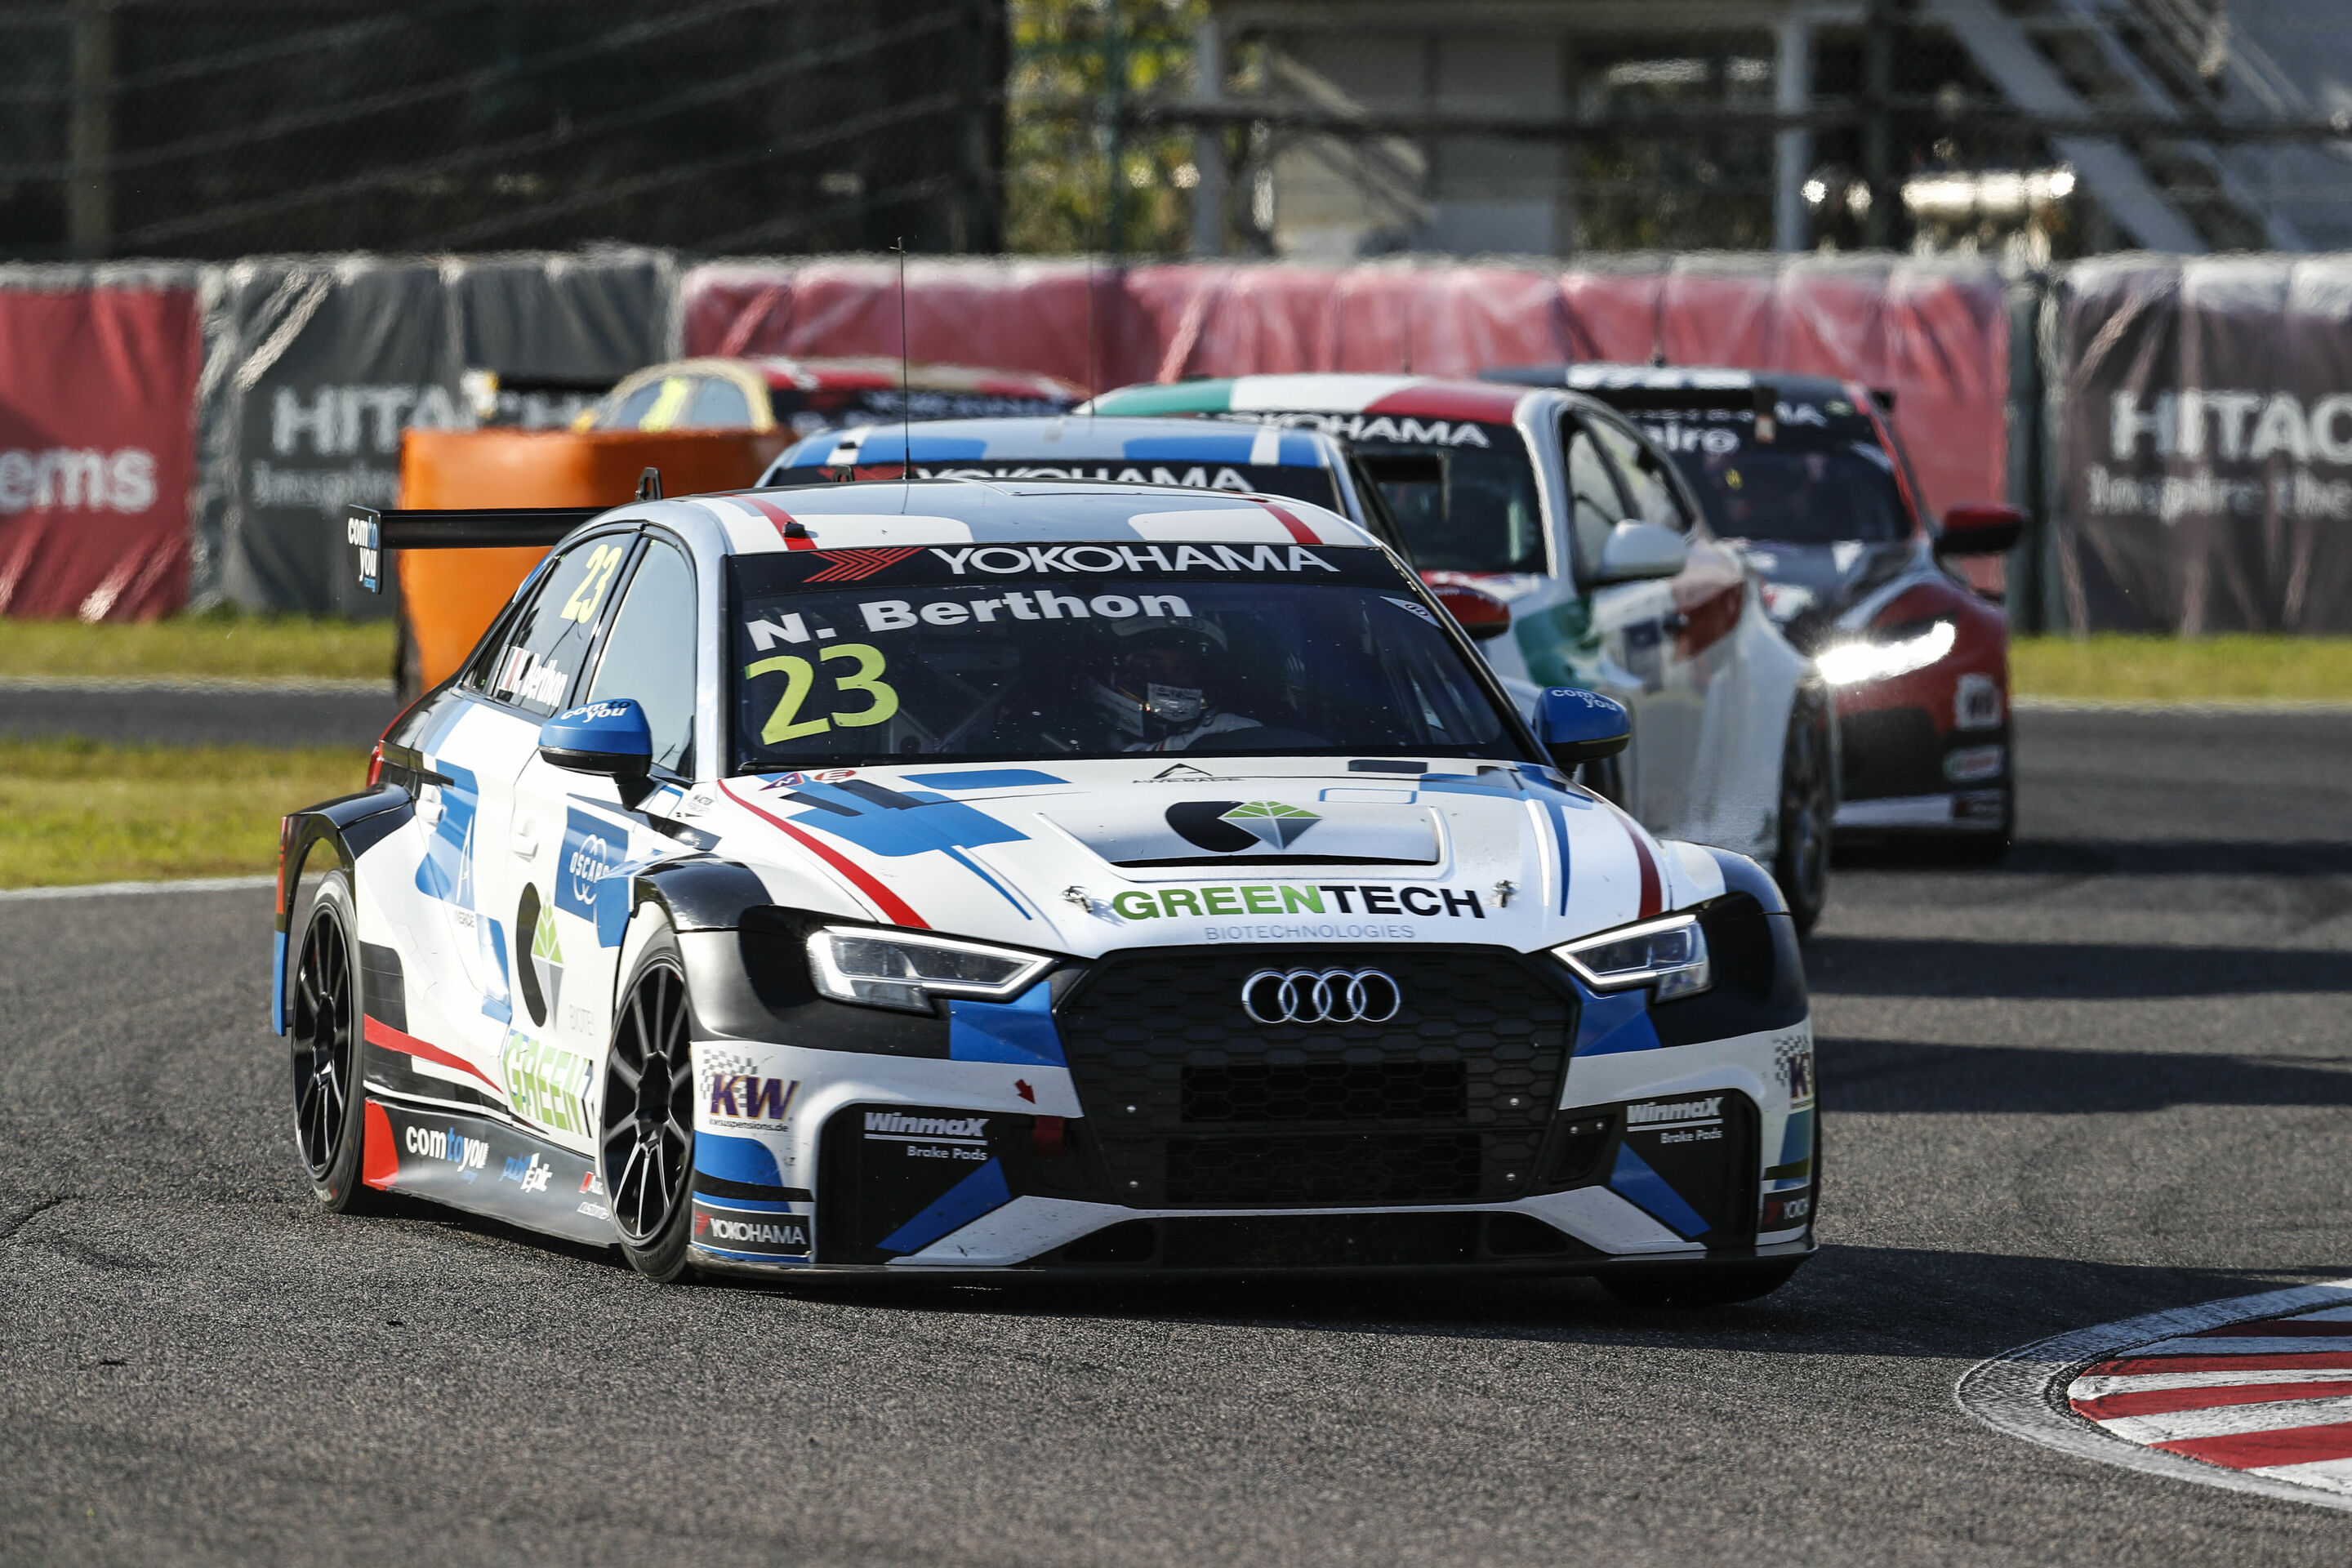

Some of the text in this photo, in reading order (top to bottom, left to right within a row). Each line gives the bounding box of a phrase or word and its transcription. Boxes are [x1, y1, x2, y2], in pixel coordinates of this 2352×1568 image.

[929, 544, 1341, 575] YOKOHAMA
[560, 544, 623, 624] 23
[746, 590, 1192, 652] N. Berthon
[745, 644, 899, 745] 23
[1113, 885, 1486, 920] GREENTECH
[1205, 923, 1416, 942] BIOTECHNOLOGIES
[710, 1073, 801, 1120] KW
[1660, 1127, 1723, 1143] Brake Pads
[906, 1145, 988, 1161] Brake Pads
[710, 1218, 808, 1245] YOKOHAMA
